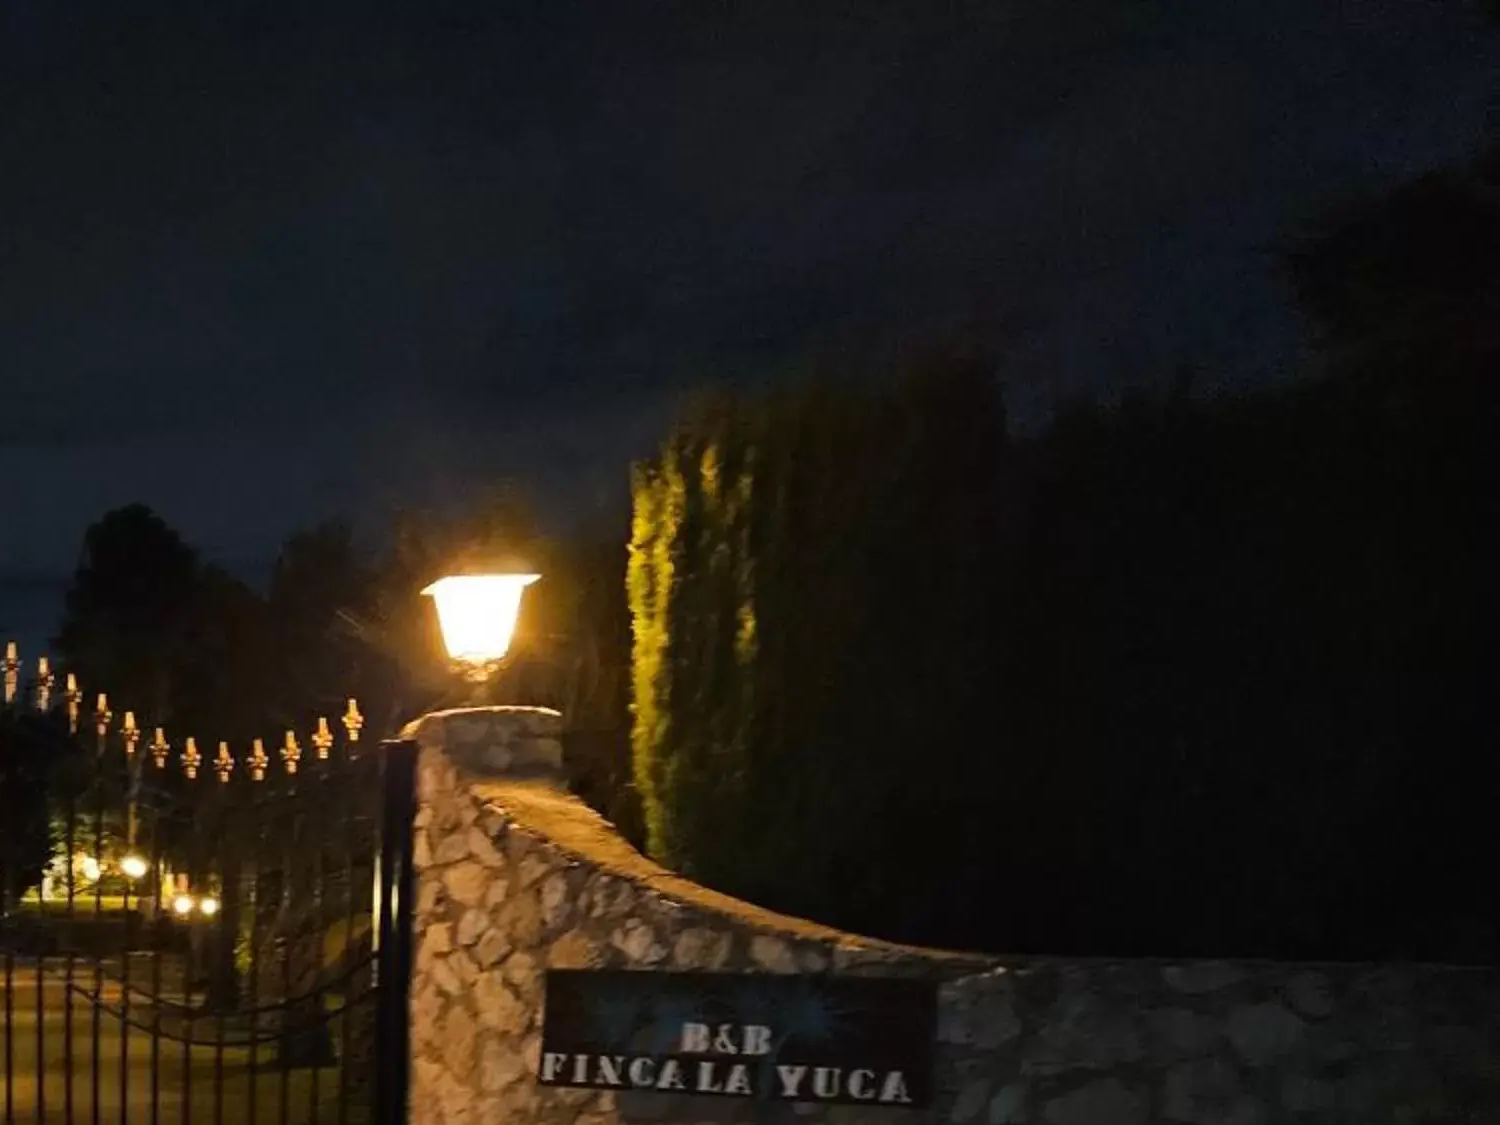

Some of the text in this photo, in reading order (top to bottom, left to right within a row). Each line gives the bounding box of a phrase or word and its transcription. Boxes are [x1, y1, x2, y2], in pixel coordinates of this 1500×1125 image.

[680, 1022, 774, 1055] B&B
[541, 1053, 913, 1103] FINCA LA YUCA
